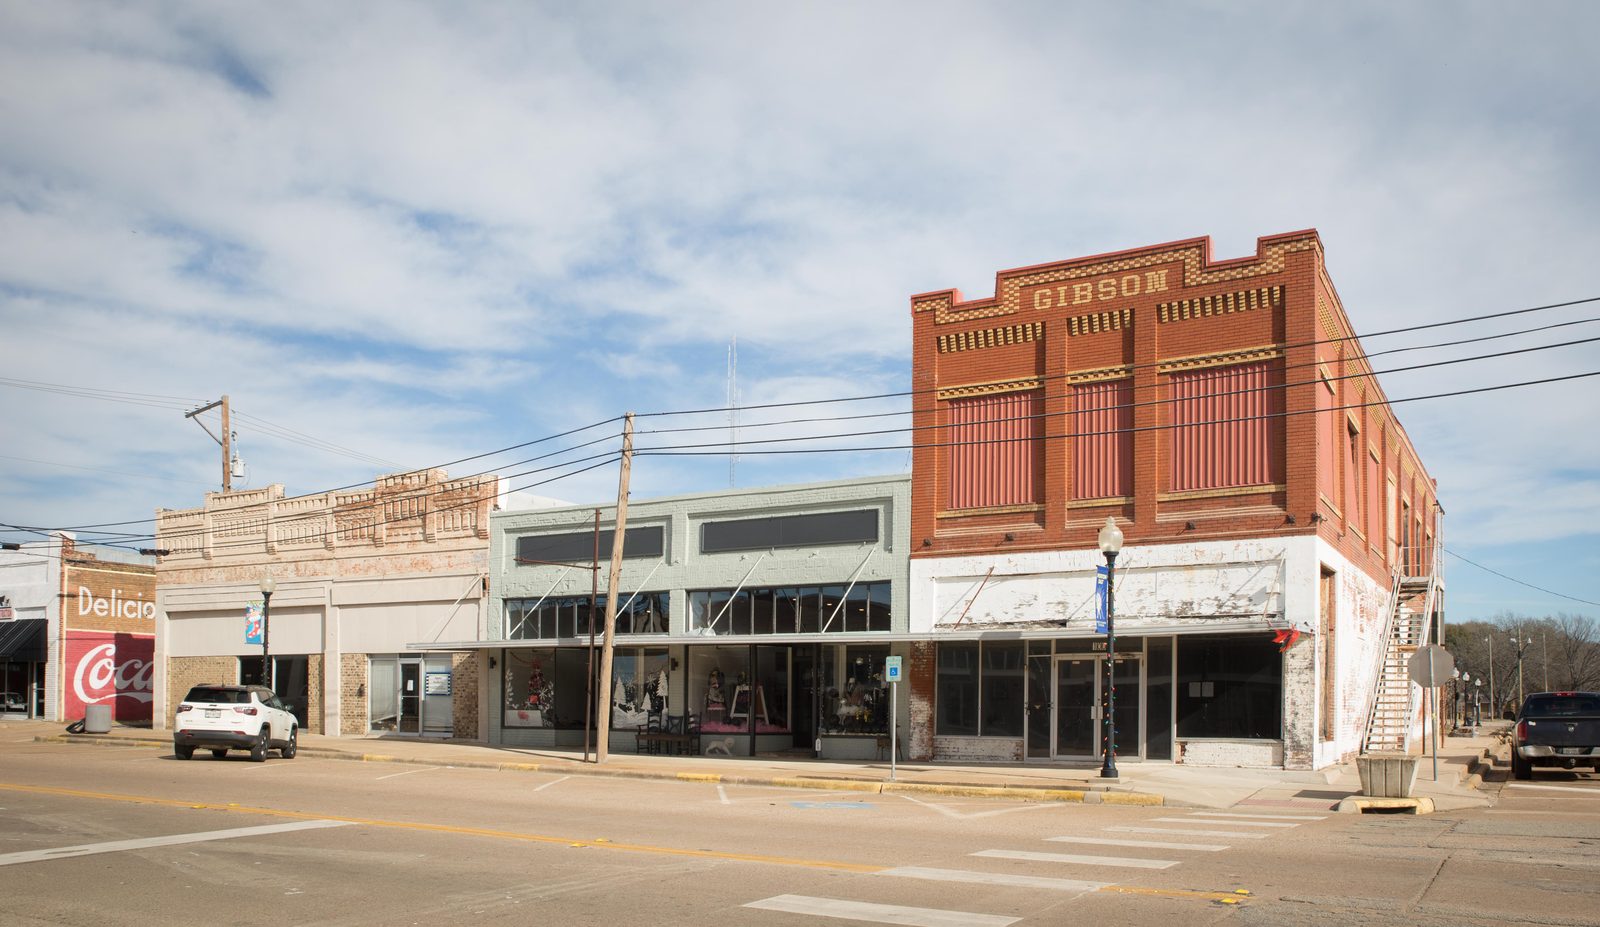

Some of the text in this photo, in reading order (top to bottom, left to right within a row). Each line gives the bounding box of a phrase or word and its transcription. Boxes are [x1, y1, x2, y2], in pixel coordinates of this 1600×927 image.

[1034, 269, 1169, 310] GIBSON
[79, 586, 156, 620] Delicio
[74, 643, 153, 704] Coca
